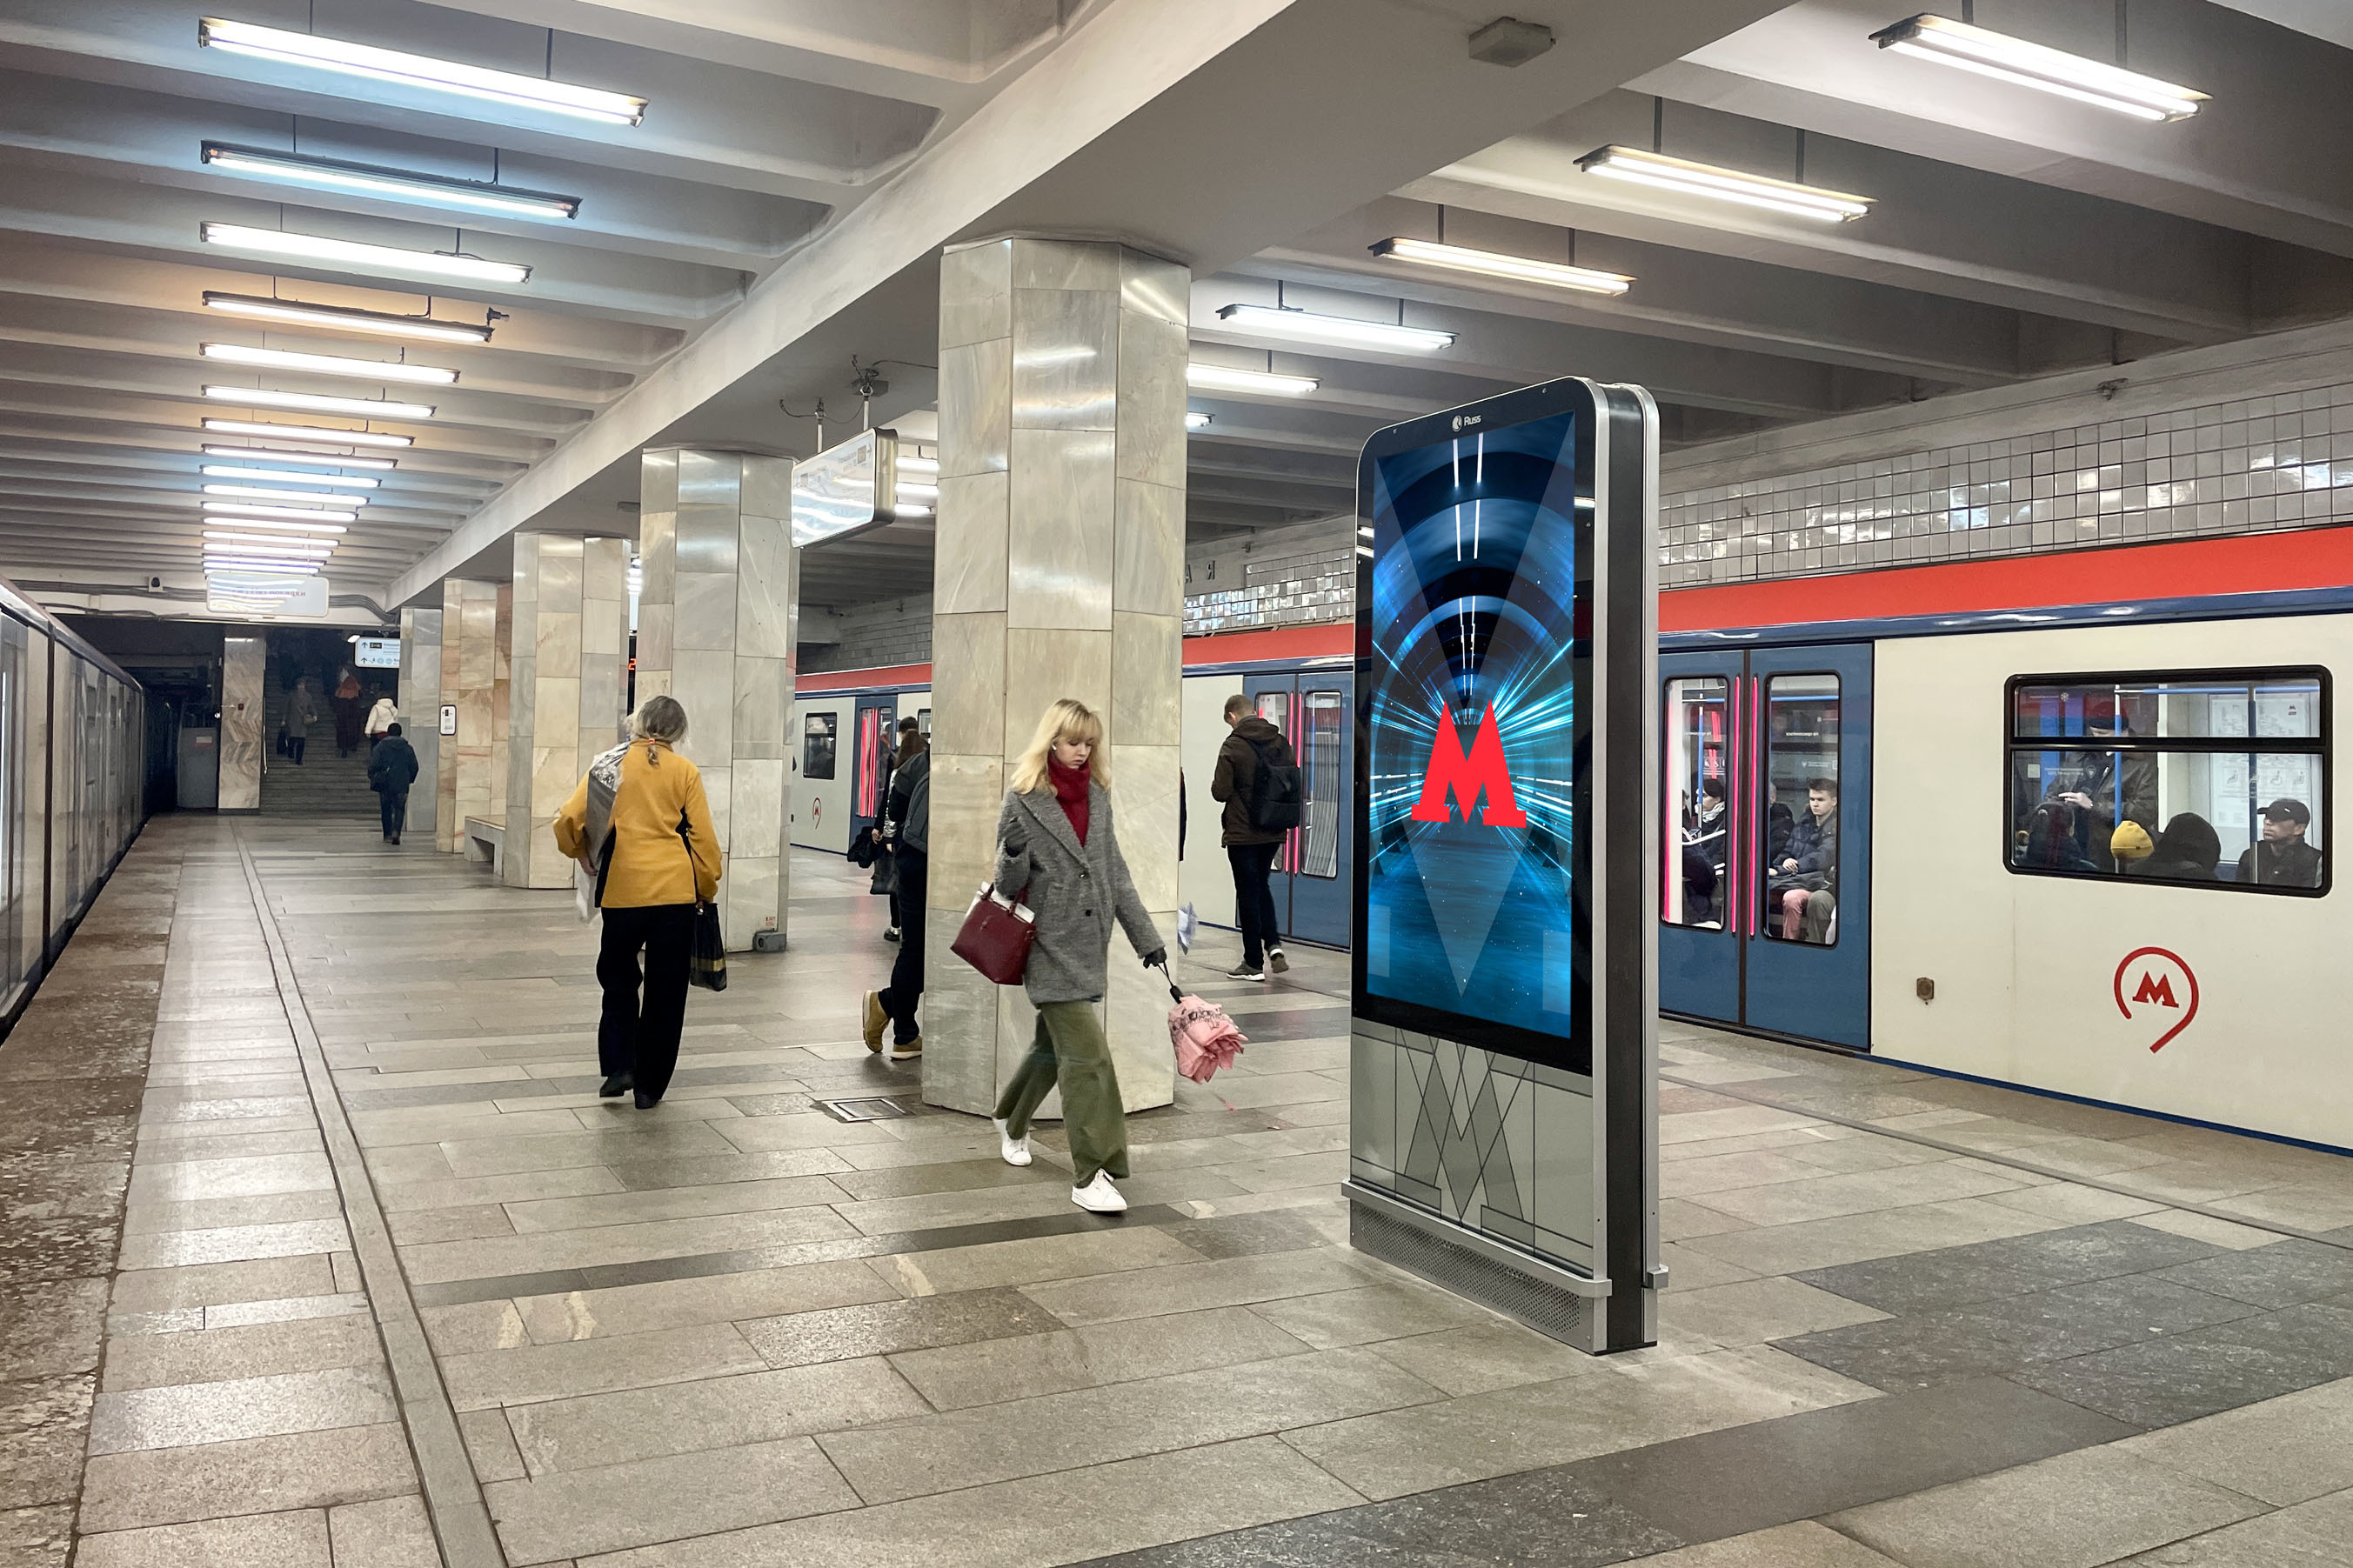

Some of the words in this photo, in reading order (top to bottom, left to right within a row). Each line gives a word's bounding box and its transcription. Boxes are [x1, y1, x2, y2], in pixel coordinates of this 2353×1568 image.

[1464, 415, 1481, 426] Russ
[1411, 697, 1527, 829] М
[2132, 971, 2179, 1008] М
